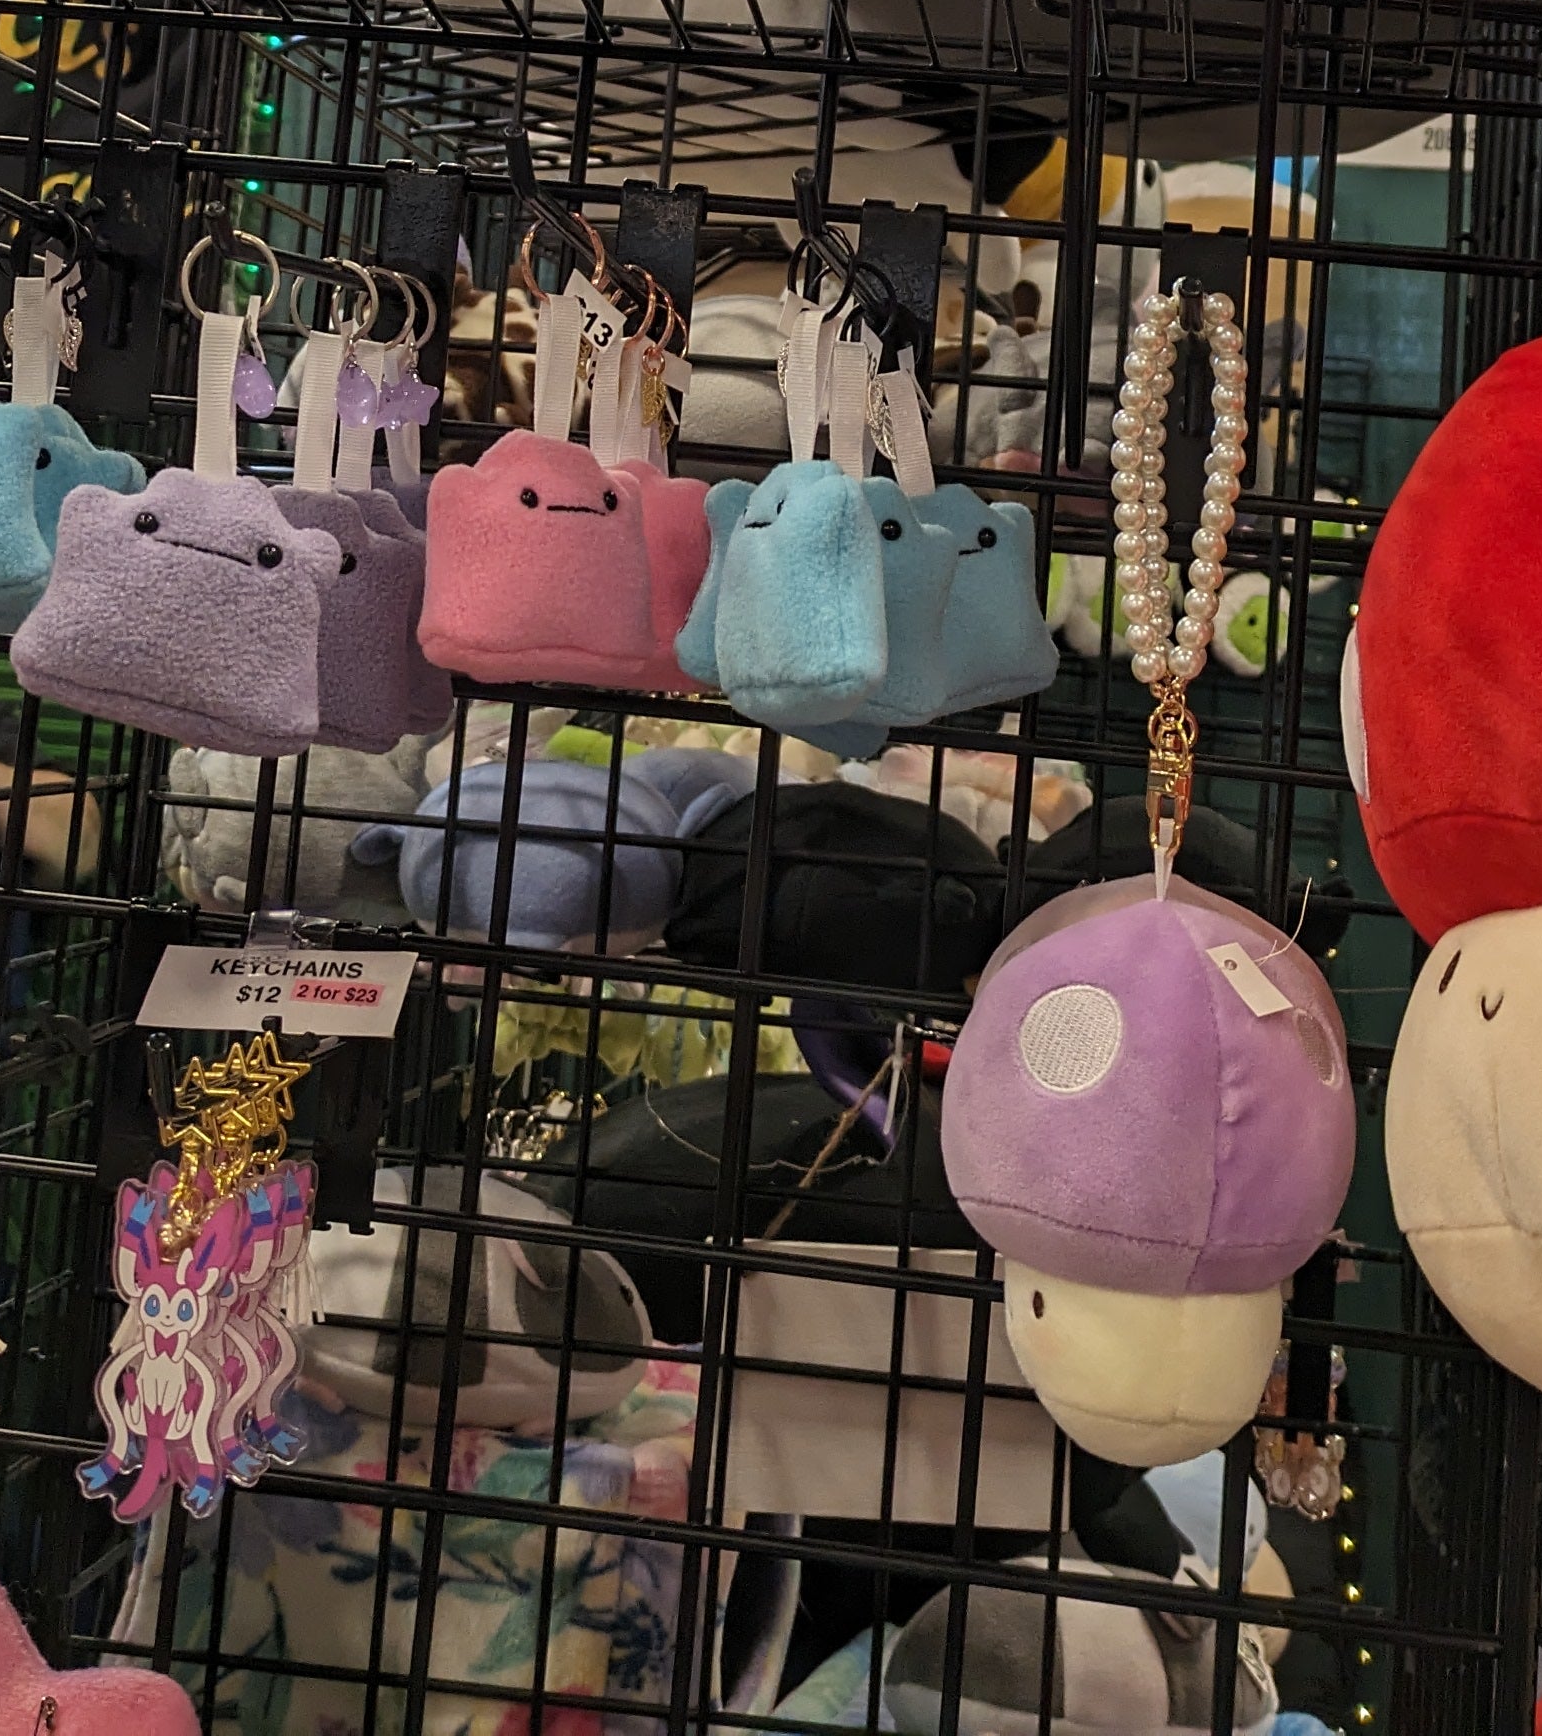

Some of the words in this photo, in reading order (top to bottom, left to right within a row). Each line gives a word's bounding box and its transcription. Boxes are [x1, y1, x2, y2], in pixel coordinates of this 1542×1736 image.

[211, 958, 364, 979] KEYCHAINS
[236, 985, 281, 1003] $12
[296, 984, 310, 998] 2
[313, 985, 342, 1001] for
[344, 987, 379, 1004] $23
